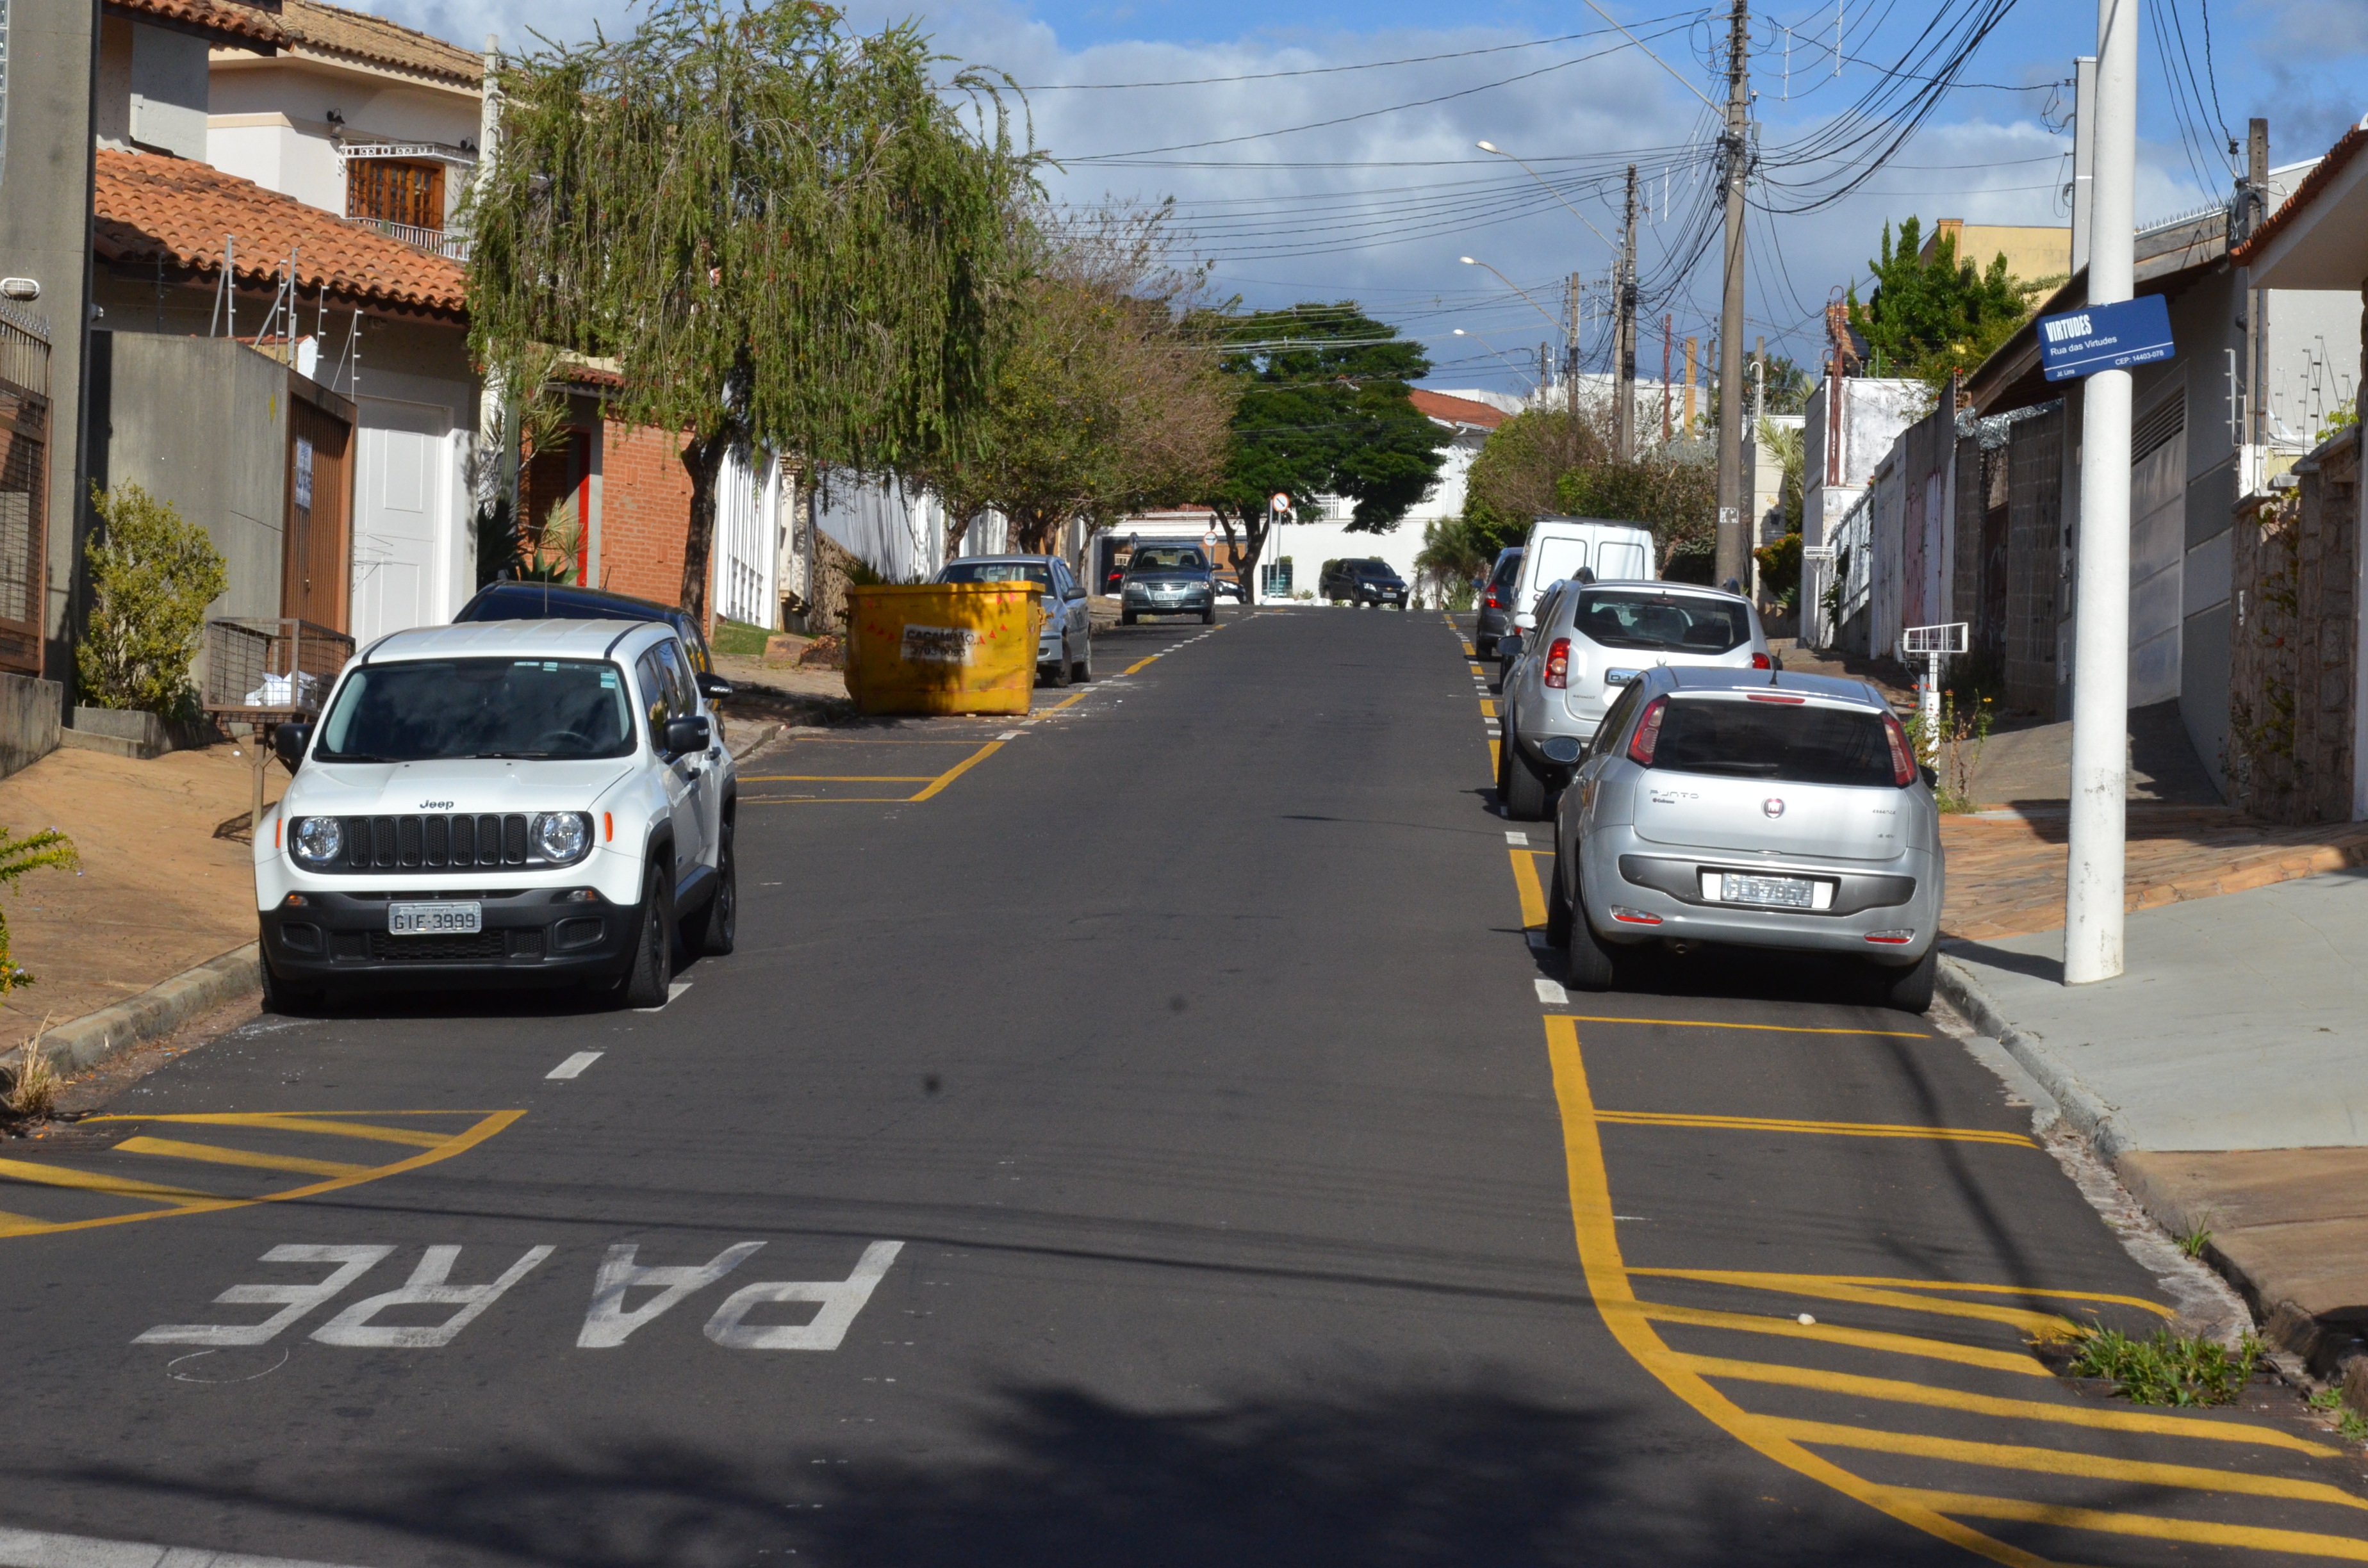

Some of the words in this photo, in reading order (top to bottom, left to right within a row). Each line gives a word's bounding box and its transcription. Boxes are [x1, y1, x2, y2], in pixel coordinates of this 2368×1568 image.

[2050, 347, 2067, 356] Rua
[2068, 344, 2084, 352] das
[2084, 336, 2117, 348] Virtudes
[2115, 357, 2132, 365] CEP:
[420, 799, 454, 810] Jeep
[130, 1241, 905, 1350] PARE
